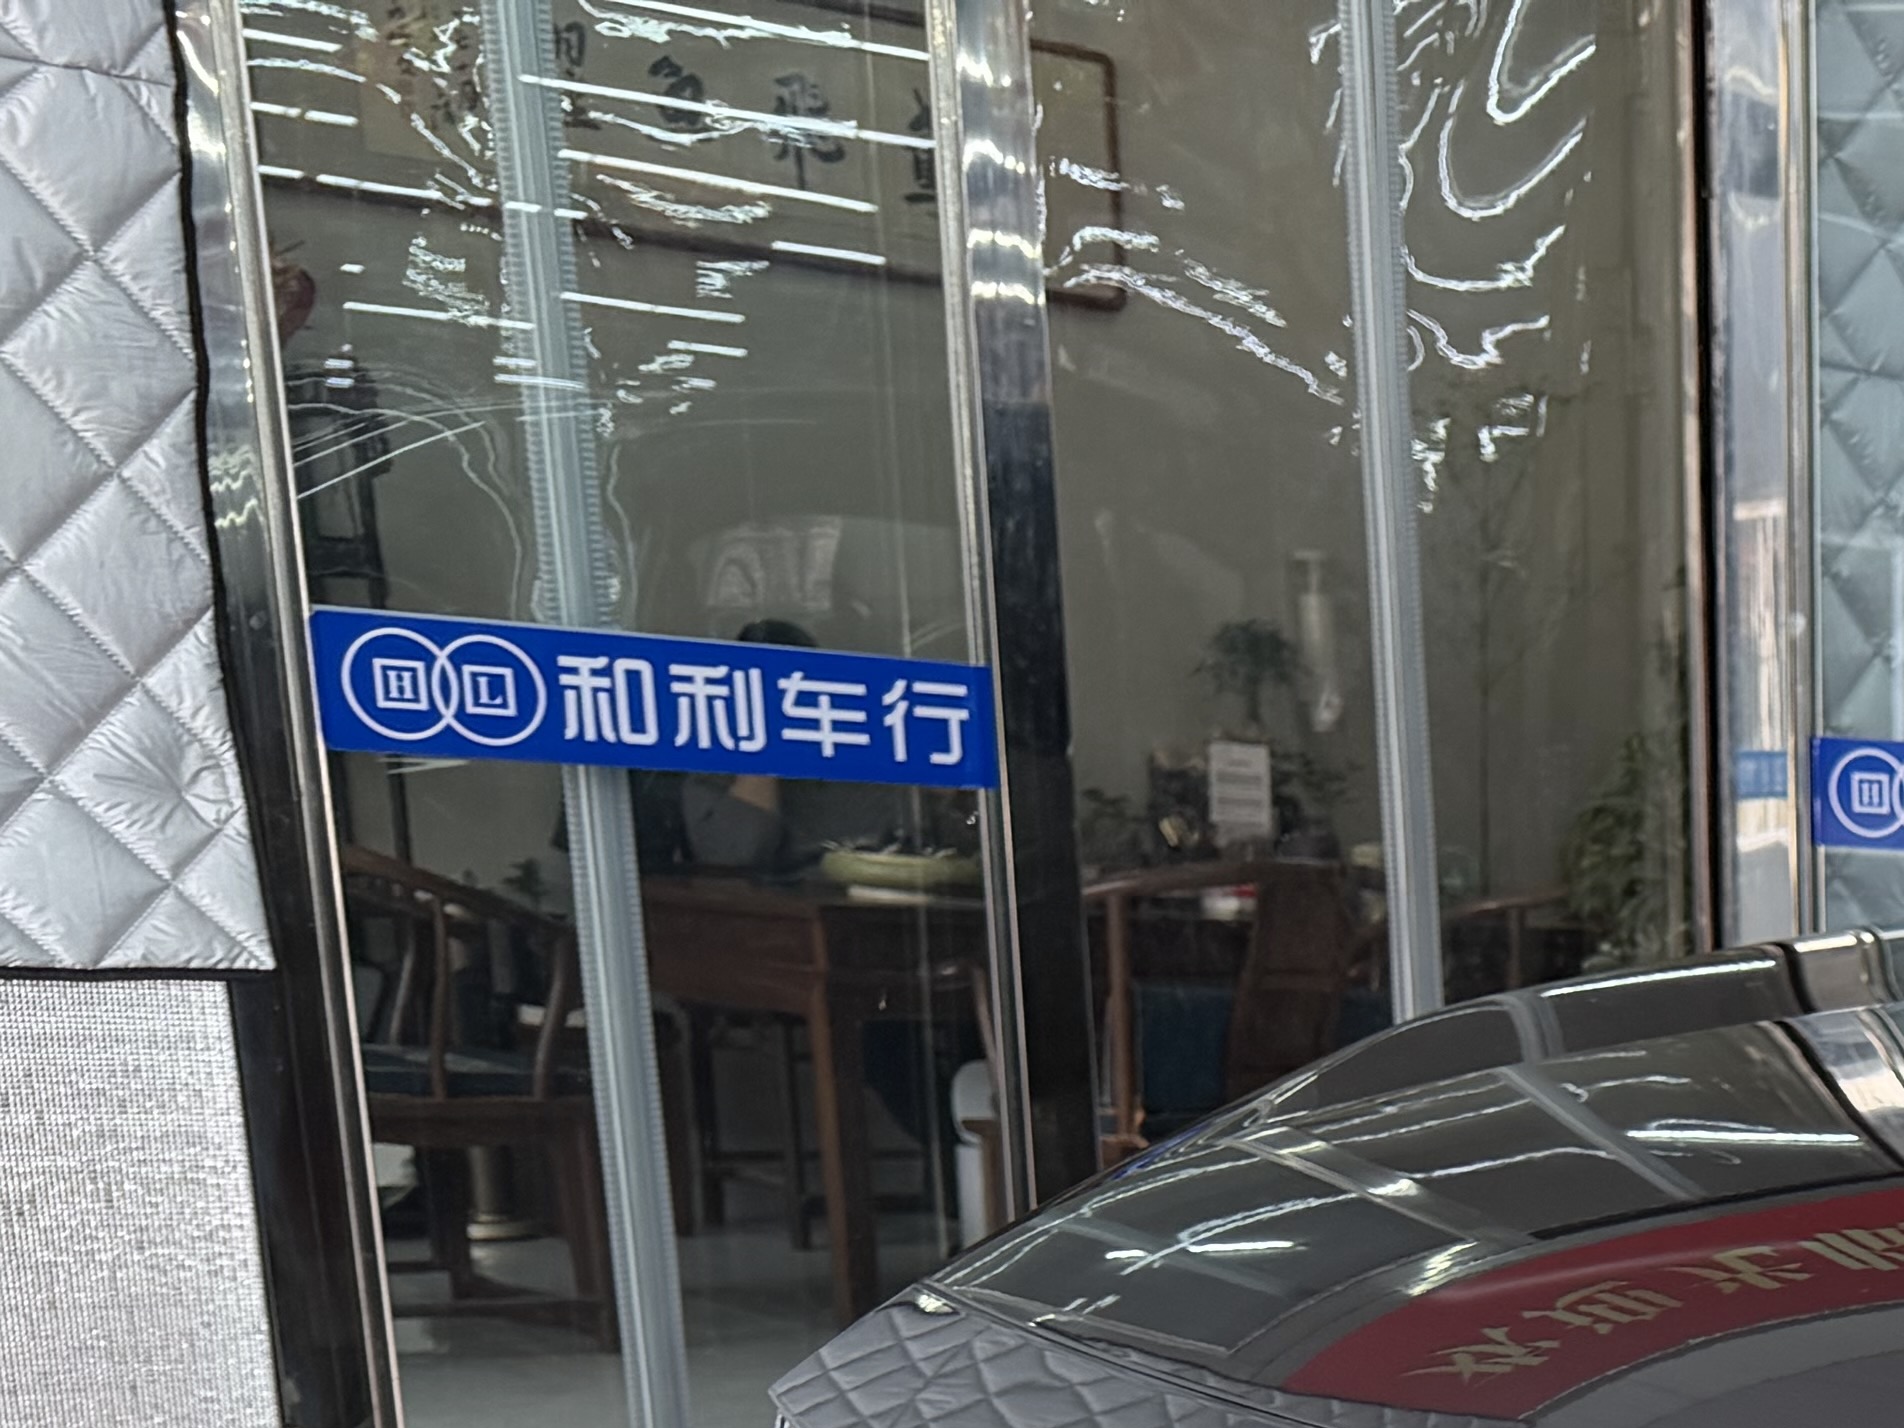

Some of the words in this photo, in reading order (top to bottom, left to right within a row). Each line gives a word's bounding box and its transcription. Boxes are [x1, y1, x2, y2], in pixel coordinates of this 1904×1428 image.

[386, 670, 416, 699] H
[476, 676, 503, 704] L
[556, 656, 970, 765] 和利车行
